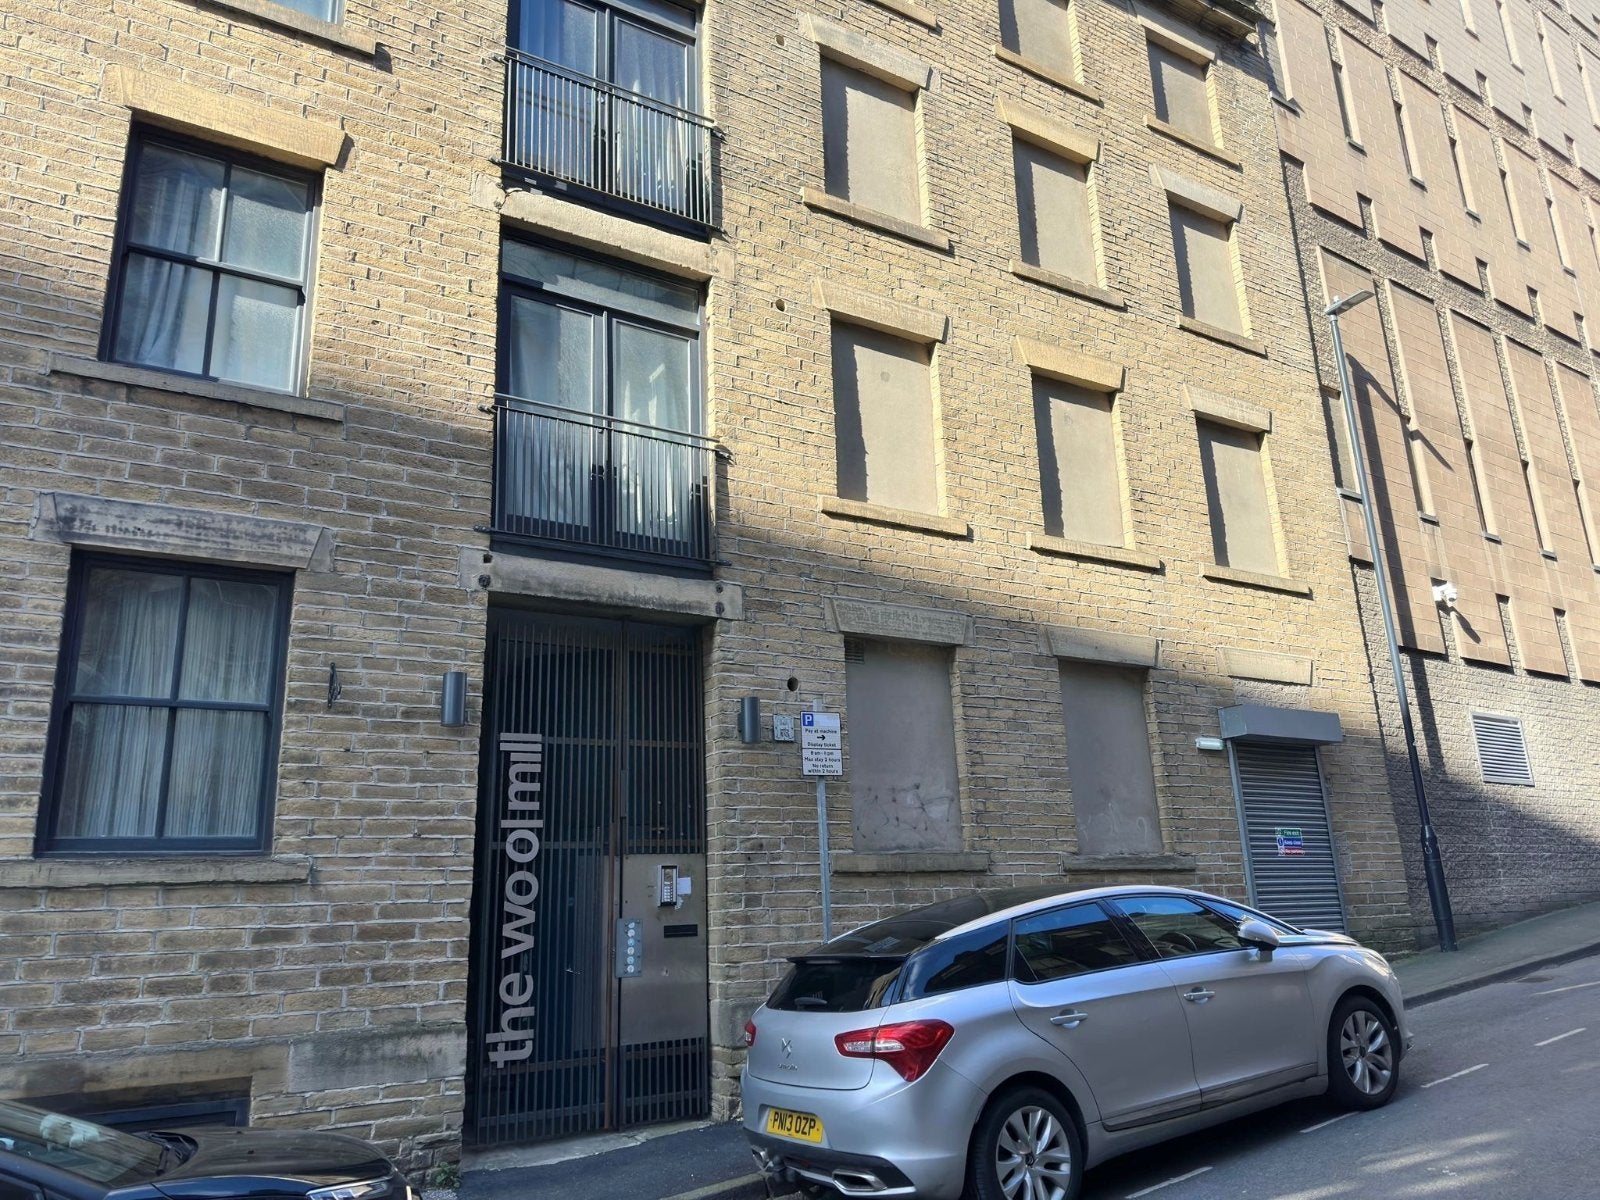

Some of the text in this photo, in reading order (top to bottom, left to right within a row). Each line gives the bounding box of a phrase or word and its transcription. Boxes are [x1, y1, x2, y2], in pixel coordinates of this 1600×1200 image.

[805, 714, 812, 725] P
[486, 972, 535, 1069] the
[772, 1111, 816, 1136] PN13 OZP
